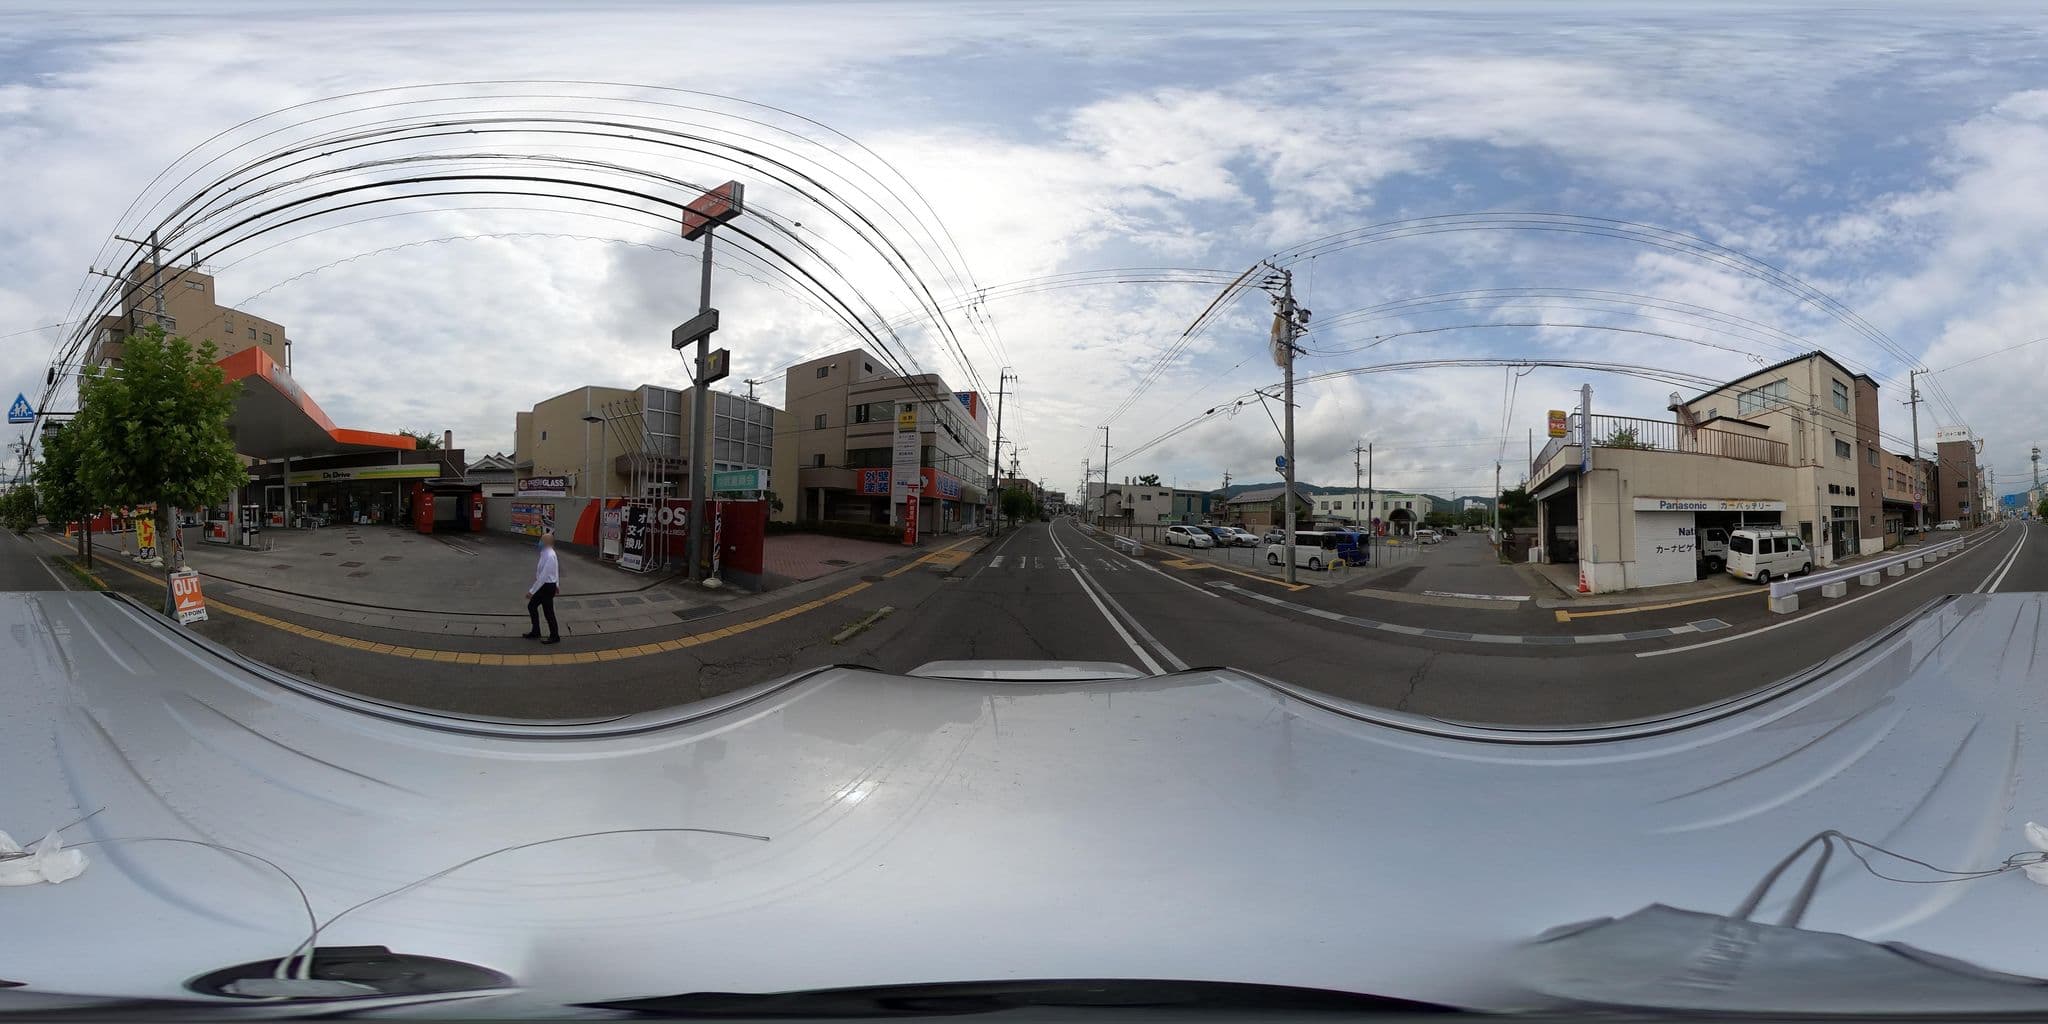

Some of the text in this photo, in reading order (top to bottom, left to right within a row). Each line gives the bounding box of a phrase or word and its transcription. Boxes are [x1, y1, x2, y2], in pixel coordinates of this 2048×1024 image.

[542, 479, 564, 487] GLASS
[1660, 500, 1771, 510] Panasonic カーバッテリー
[634, 512, 647, 550] オイル
[1656, 543, 1696, 554] カーナビゲ
[173, 578, 199, 596] OUT
